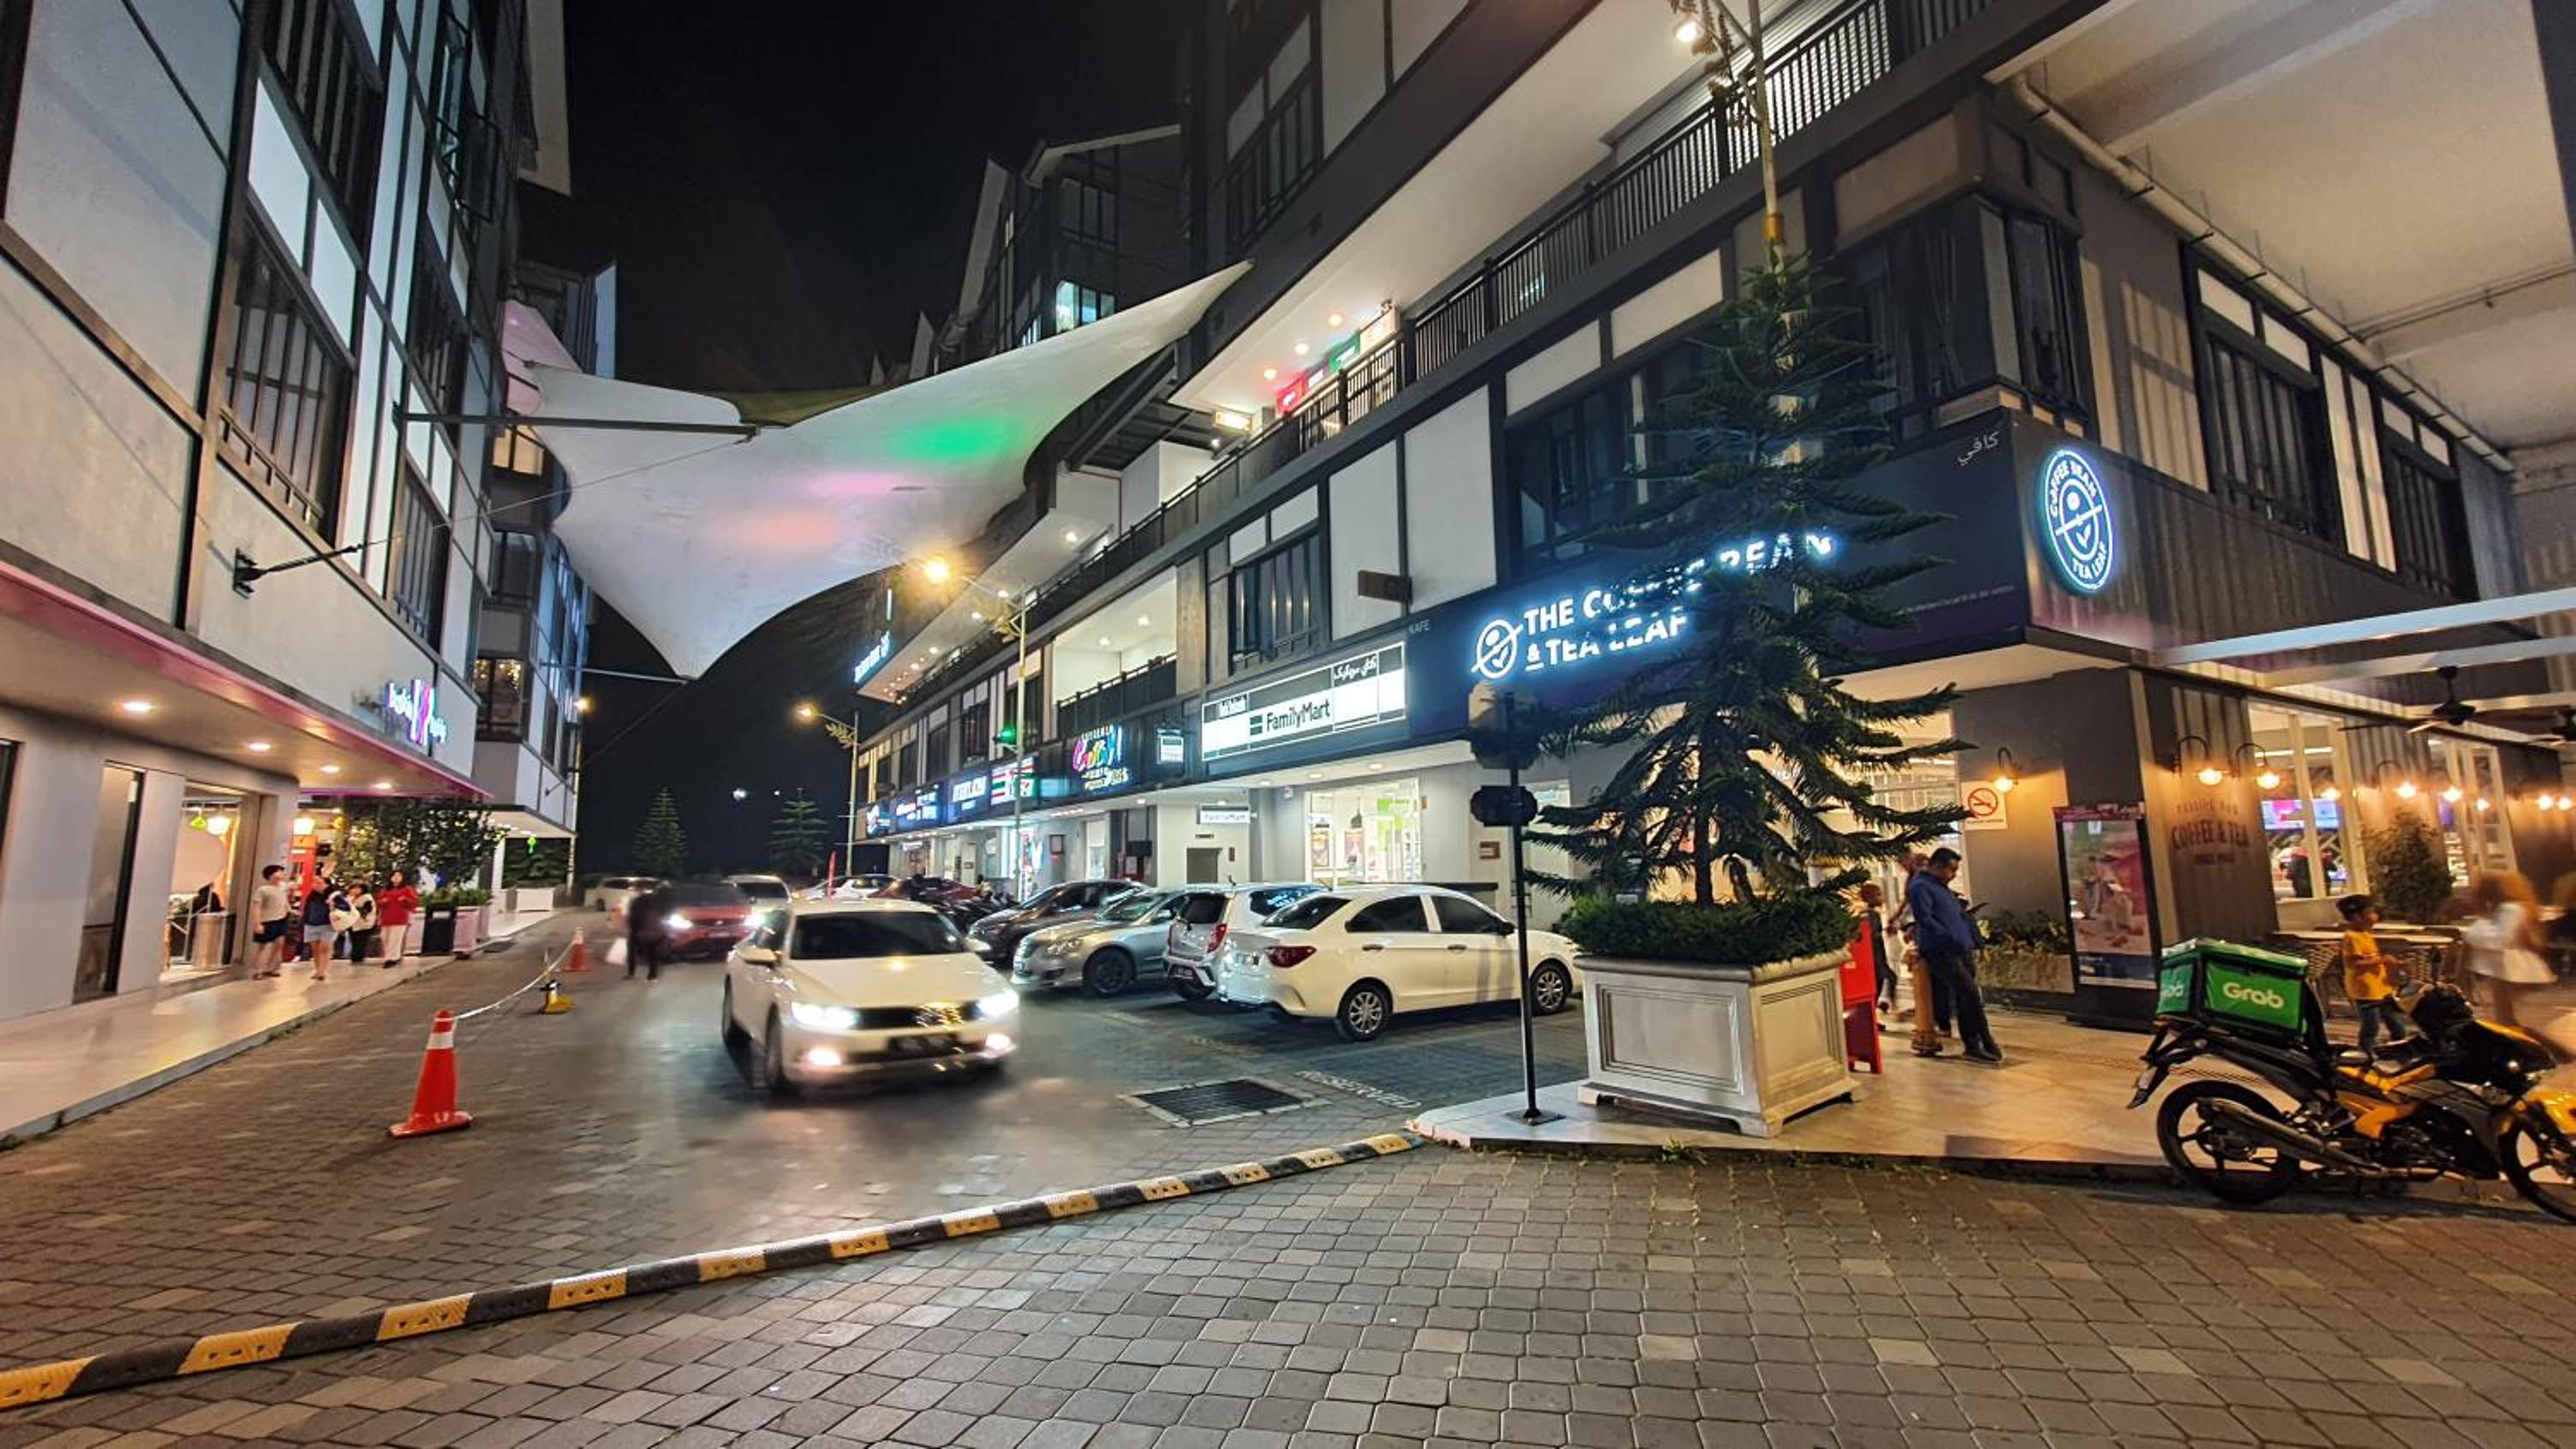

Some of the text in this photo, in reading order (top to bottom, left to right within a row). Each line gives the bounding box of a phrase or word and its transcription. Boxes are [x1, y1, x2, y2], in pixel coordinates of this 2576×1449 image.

[2069, 459, 2098, 499] BEAN
[2072, 556, 2093, 580] TEA
[1523, 597, 1575, 636] THE
[1583, 559, 1705, 619] COE
[1546, 634, 1601, 665] TEA
[1267, 699, 1331, 732] FamilyMart
[2222, 981, 2285, 1009] Grab
